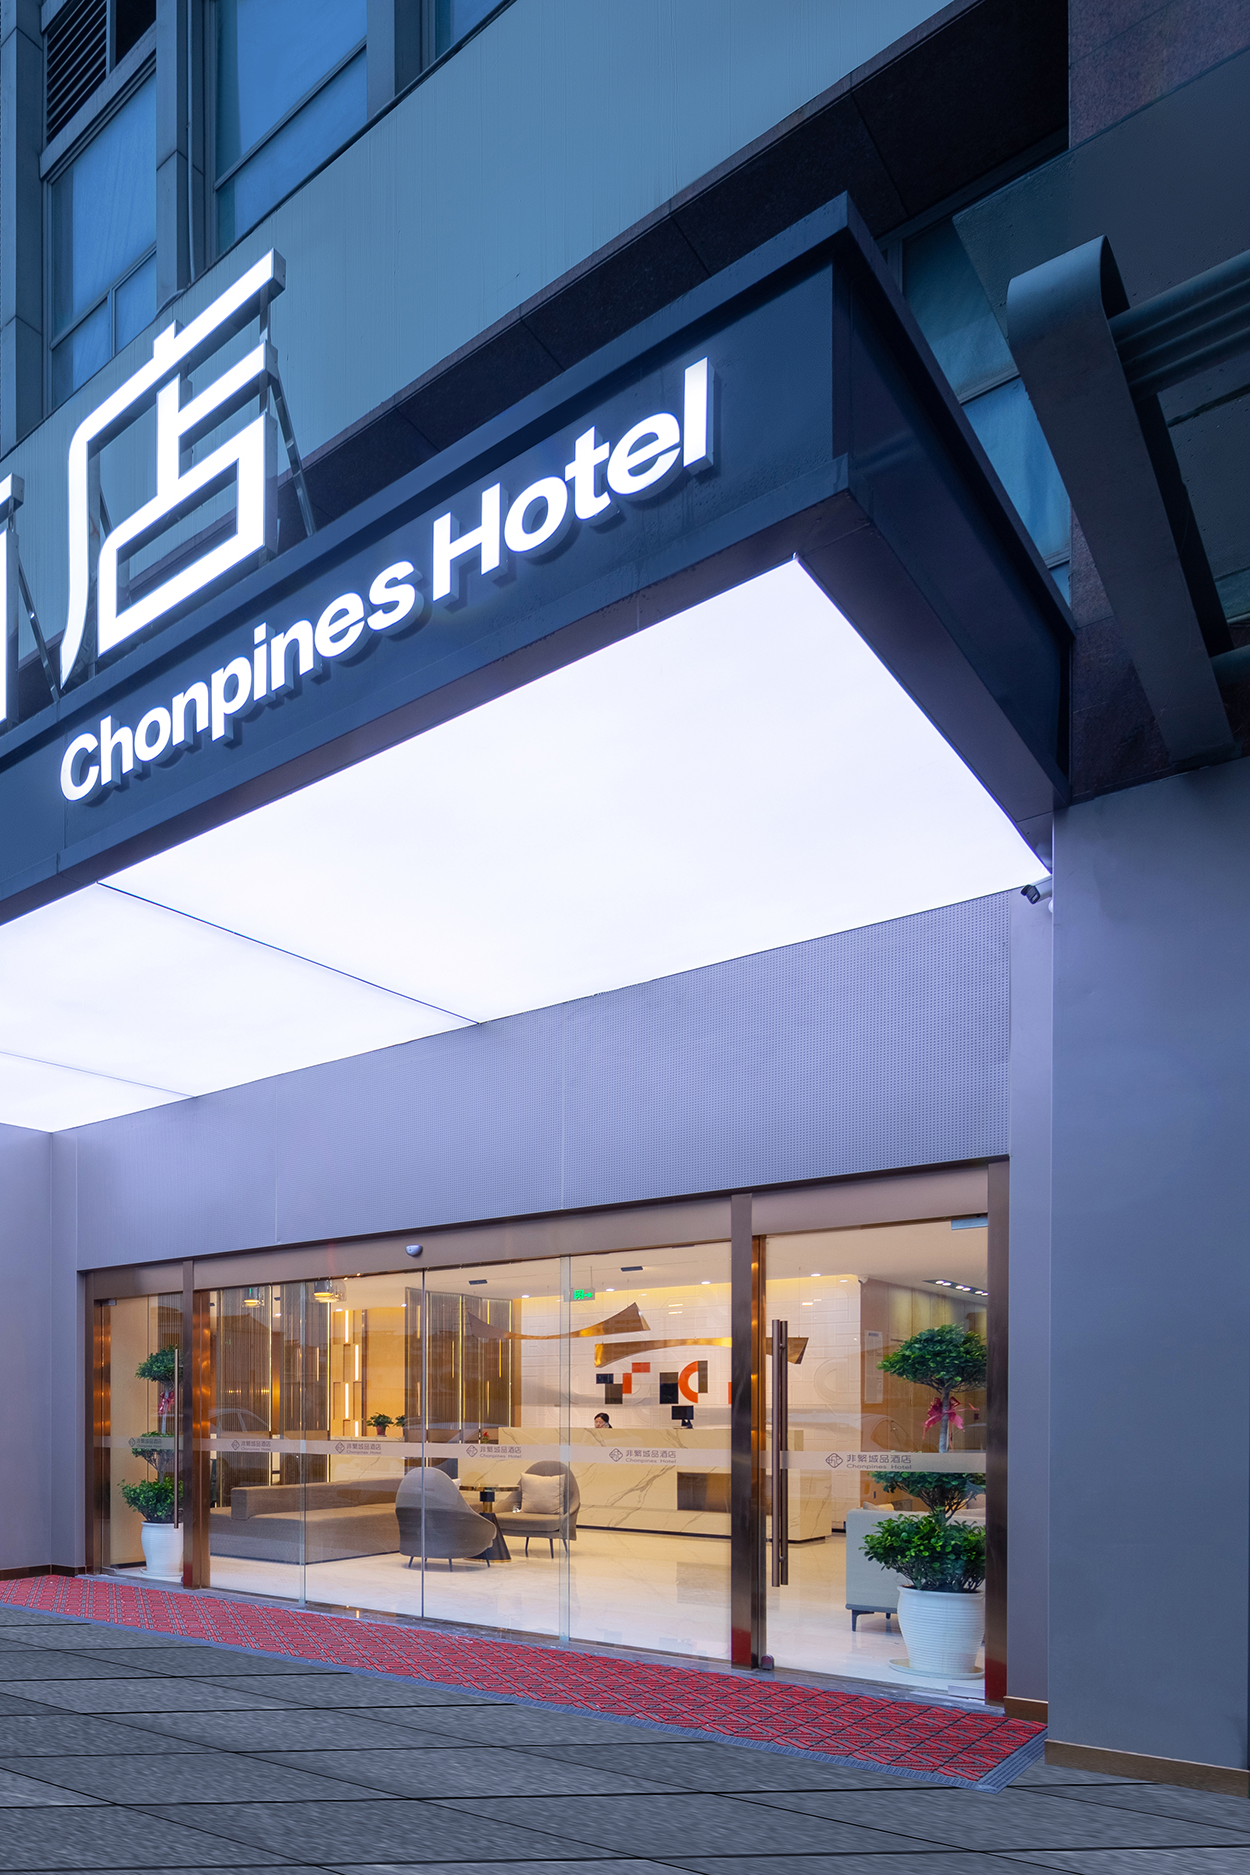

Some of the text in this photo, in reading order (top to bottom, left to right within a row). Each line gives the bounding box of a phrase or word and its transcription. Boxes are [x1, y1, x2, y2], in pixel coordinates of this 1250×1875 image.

[59, 356, 711, 802] Chonpines Hotel
[626, 1450, 676, 1458] 非繁城品酒店
[846, 1454, 912, 1464] 非繁城品酒店
